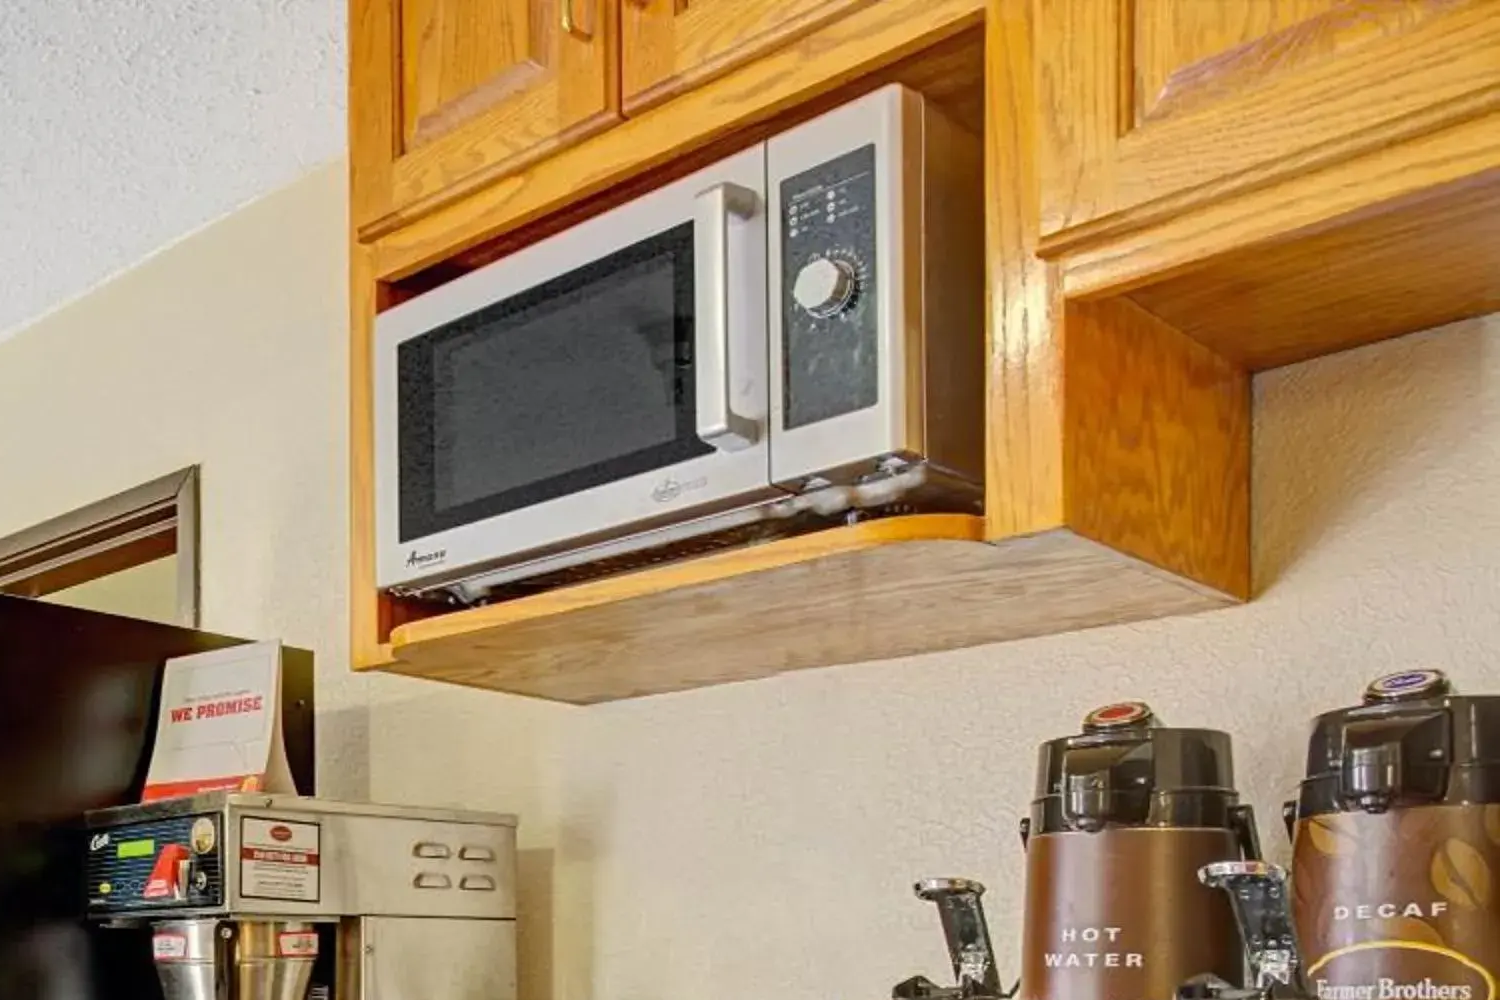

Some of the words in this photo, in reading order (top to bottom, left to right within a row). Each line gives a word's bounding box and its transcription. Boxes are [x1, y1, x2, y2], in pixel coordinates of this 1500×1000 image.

[170, 707, 193, 724] WE
[195, 697, 263, 720] PROMISE
[1333, 902, 1448, 921] DECAF
[1062, 927, 1122, 942] HOT
[1044, 953, 1144, 968] WATER
[1316, 979, 1377, 1000] Farmer
[1378, 978, 1473, 1000] Brothers
